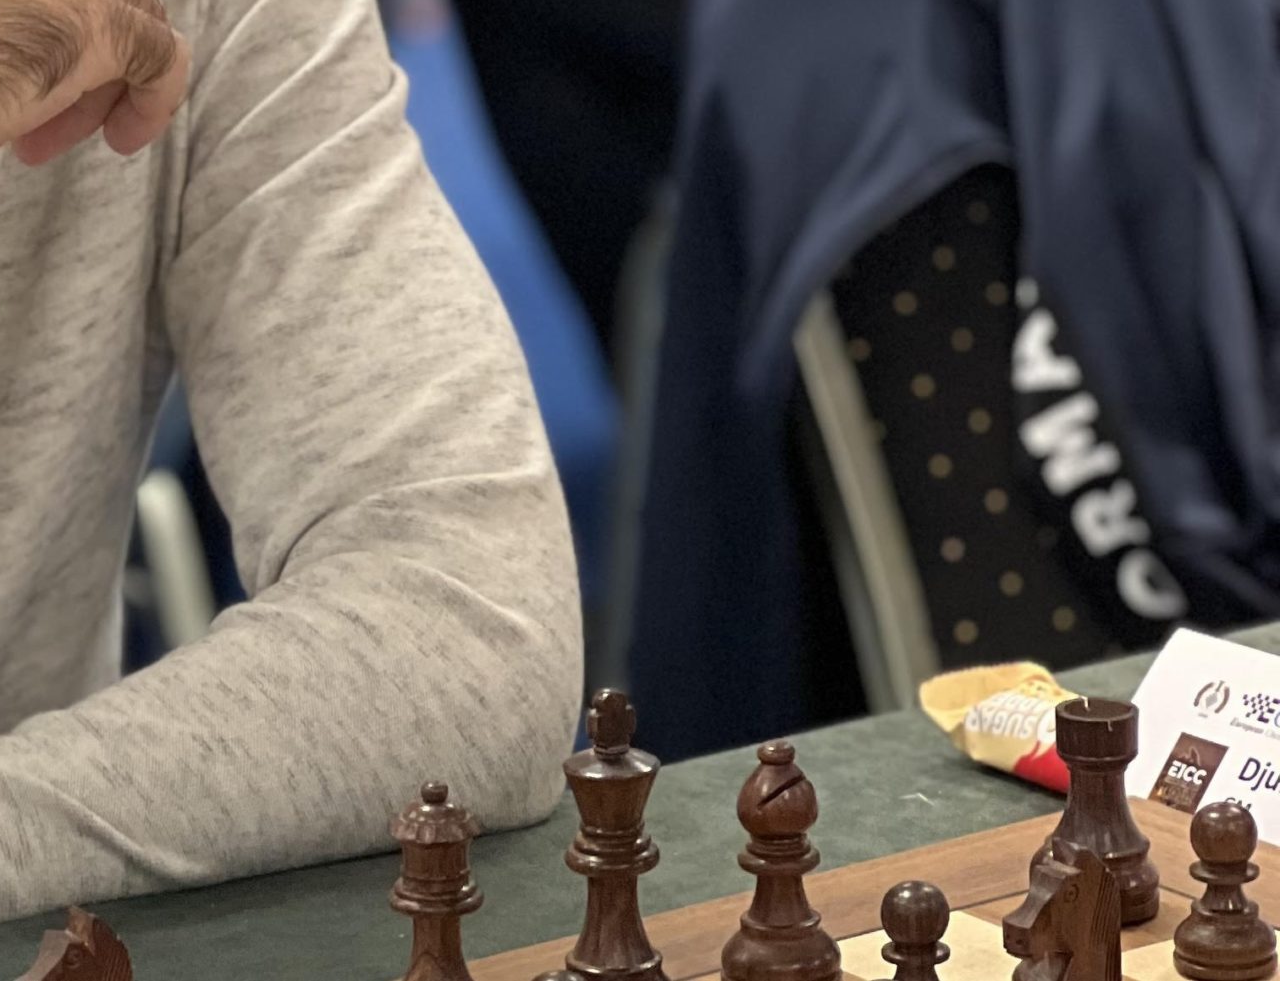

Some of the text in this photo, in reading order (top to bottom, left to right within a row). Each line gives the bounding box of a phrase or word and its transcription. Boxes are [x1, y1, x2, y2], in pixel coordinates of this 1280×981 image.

[1011, 276, 1189, 620] ORMA
[964, 706, 1034, 739] SUGAR
[1167, 760, 1207, 785] EICC
[1238, 757, 1280, 792] Dju
